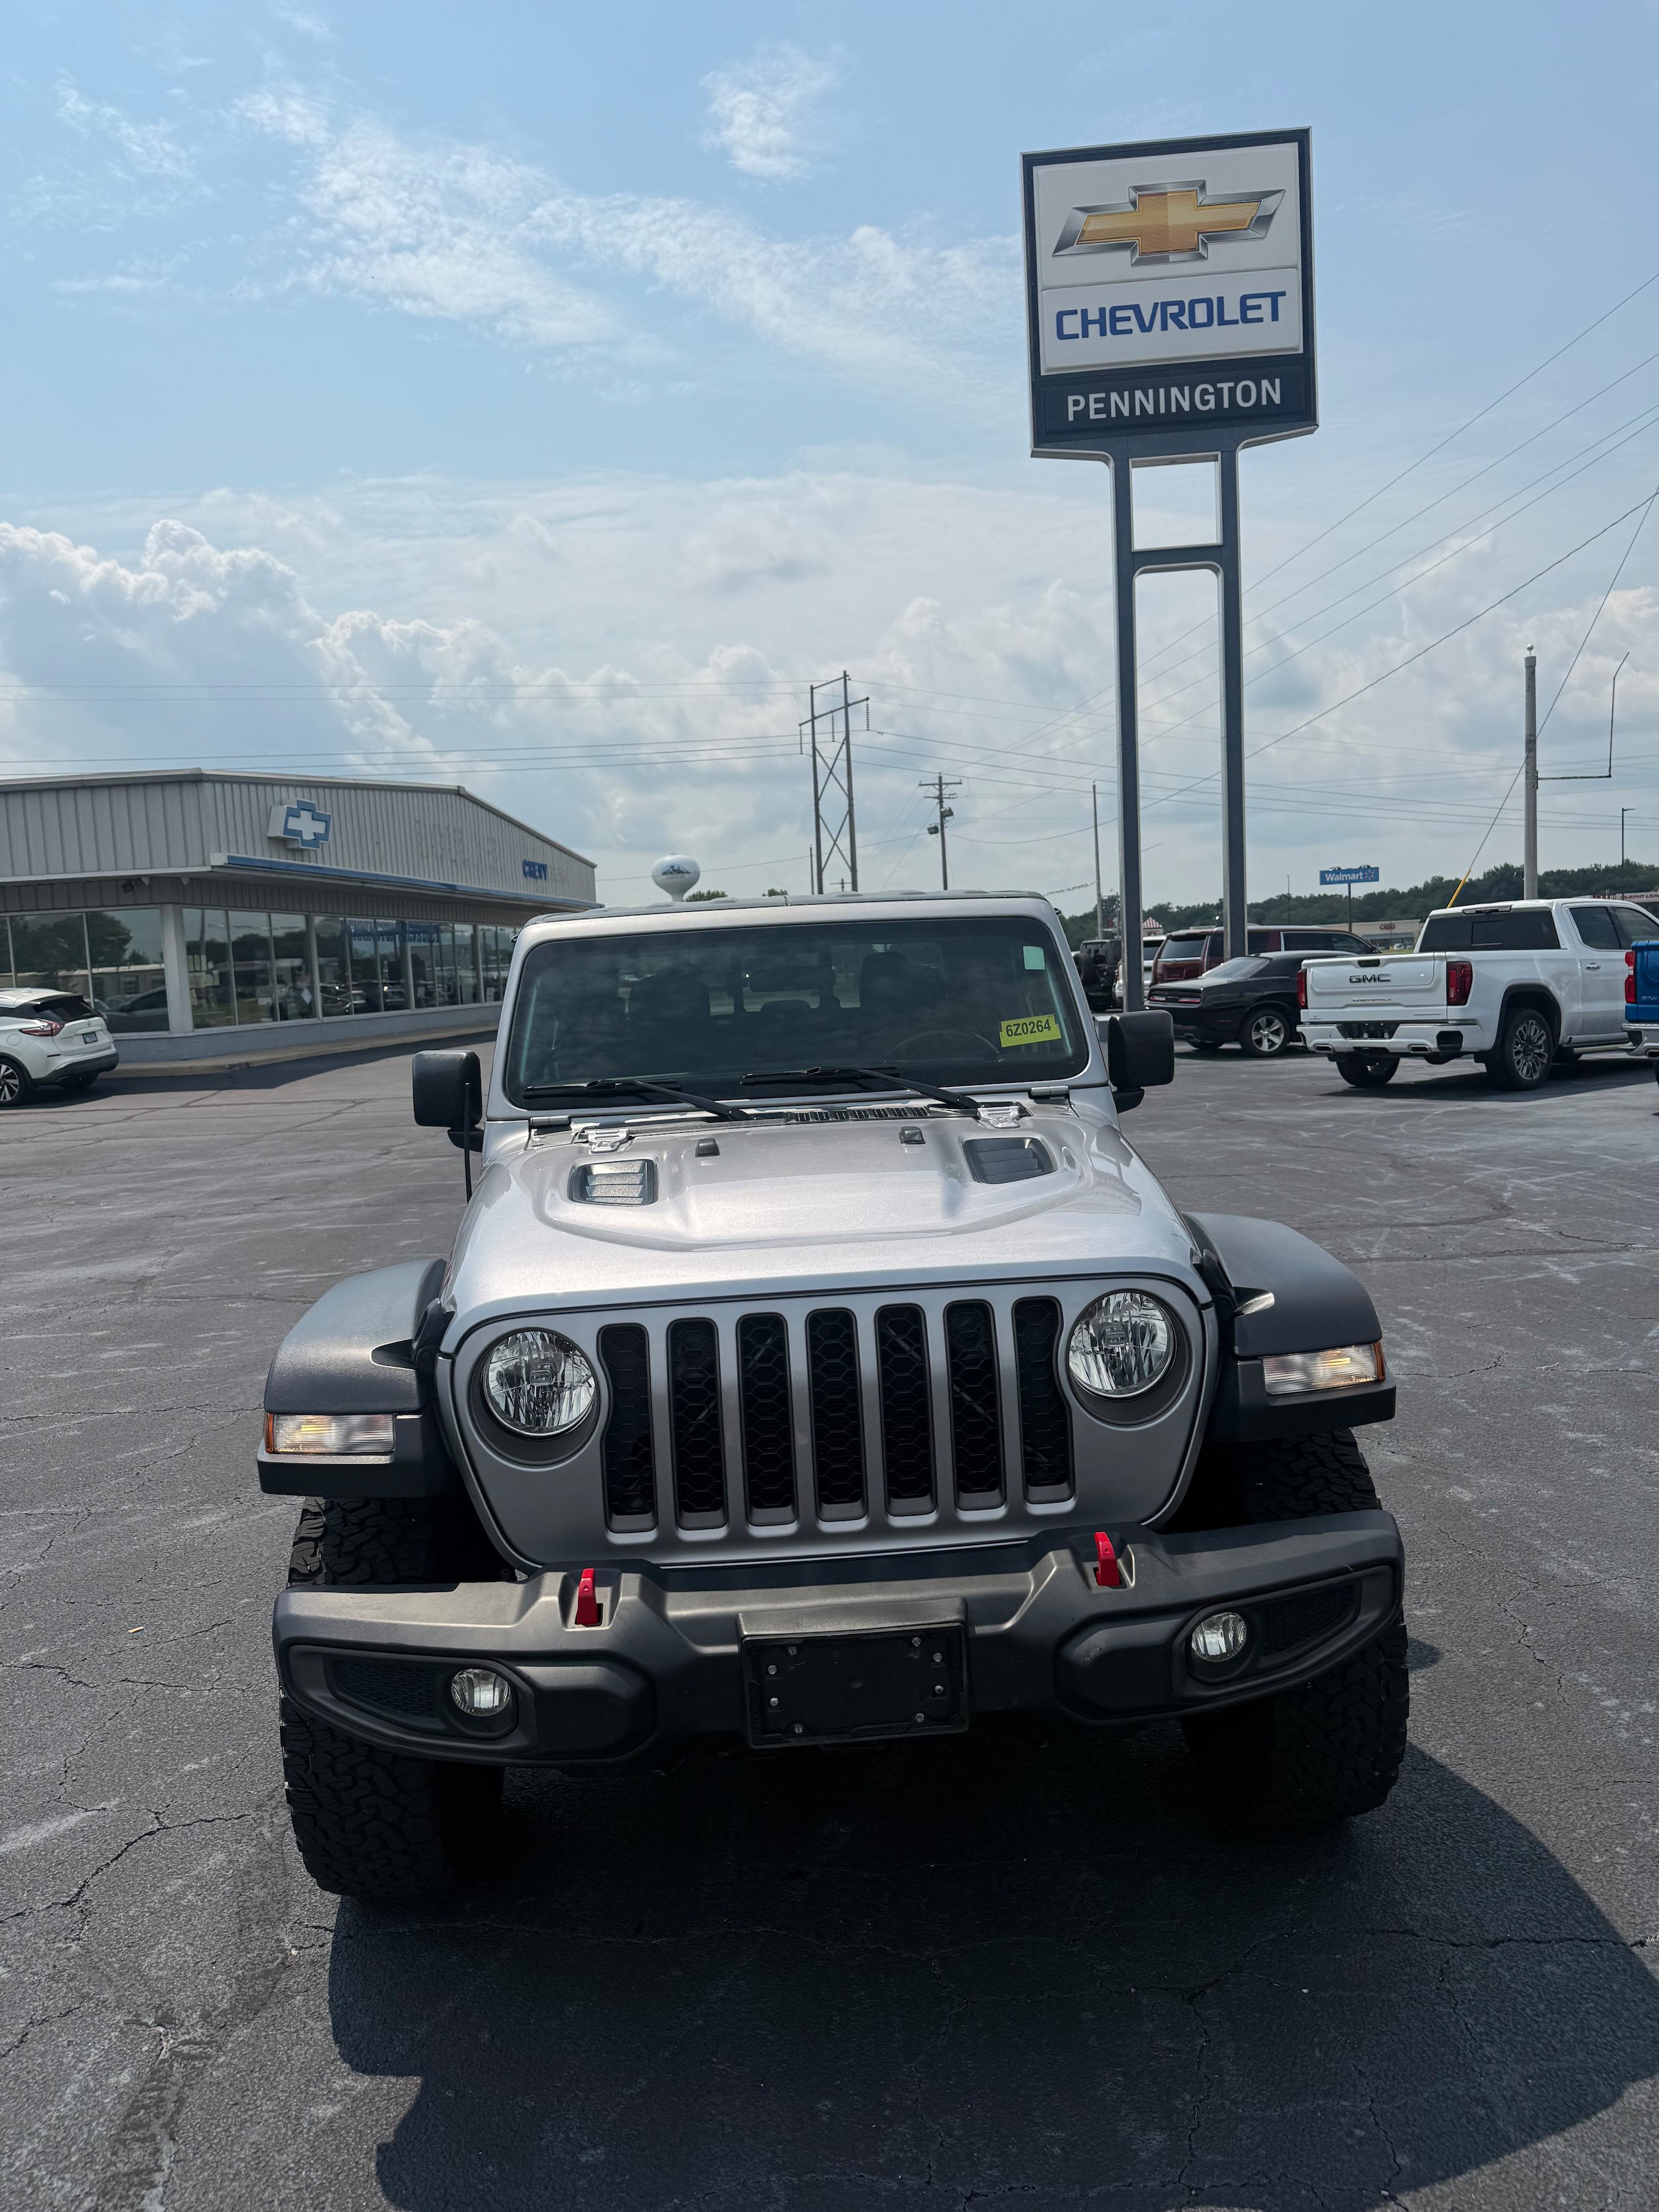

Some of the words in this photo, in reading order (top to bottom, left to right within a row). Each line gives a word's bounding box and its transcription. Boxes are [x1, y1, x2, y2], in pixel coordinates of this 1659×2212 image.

[1056, 291, 1286, 340] CHEVROLET
[1067, 378, 1281, 421] PENNINGTON
[523, 859, 547, 881] CHEVY
[1325, 871, 1363, 881] Walmart
[1349, 974, 1391, 984] GMC
[1005, 1019, 1051, 1037] 6Z0264
